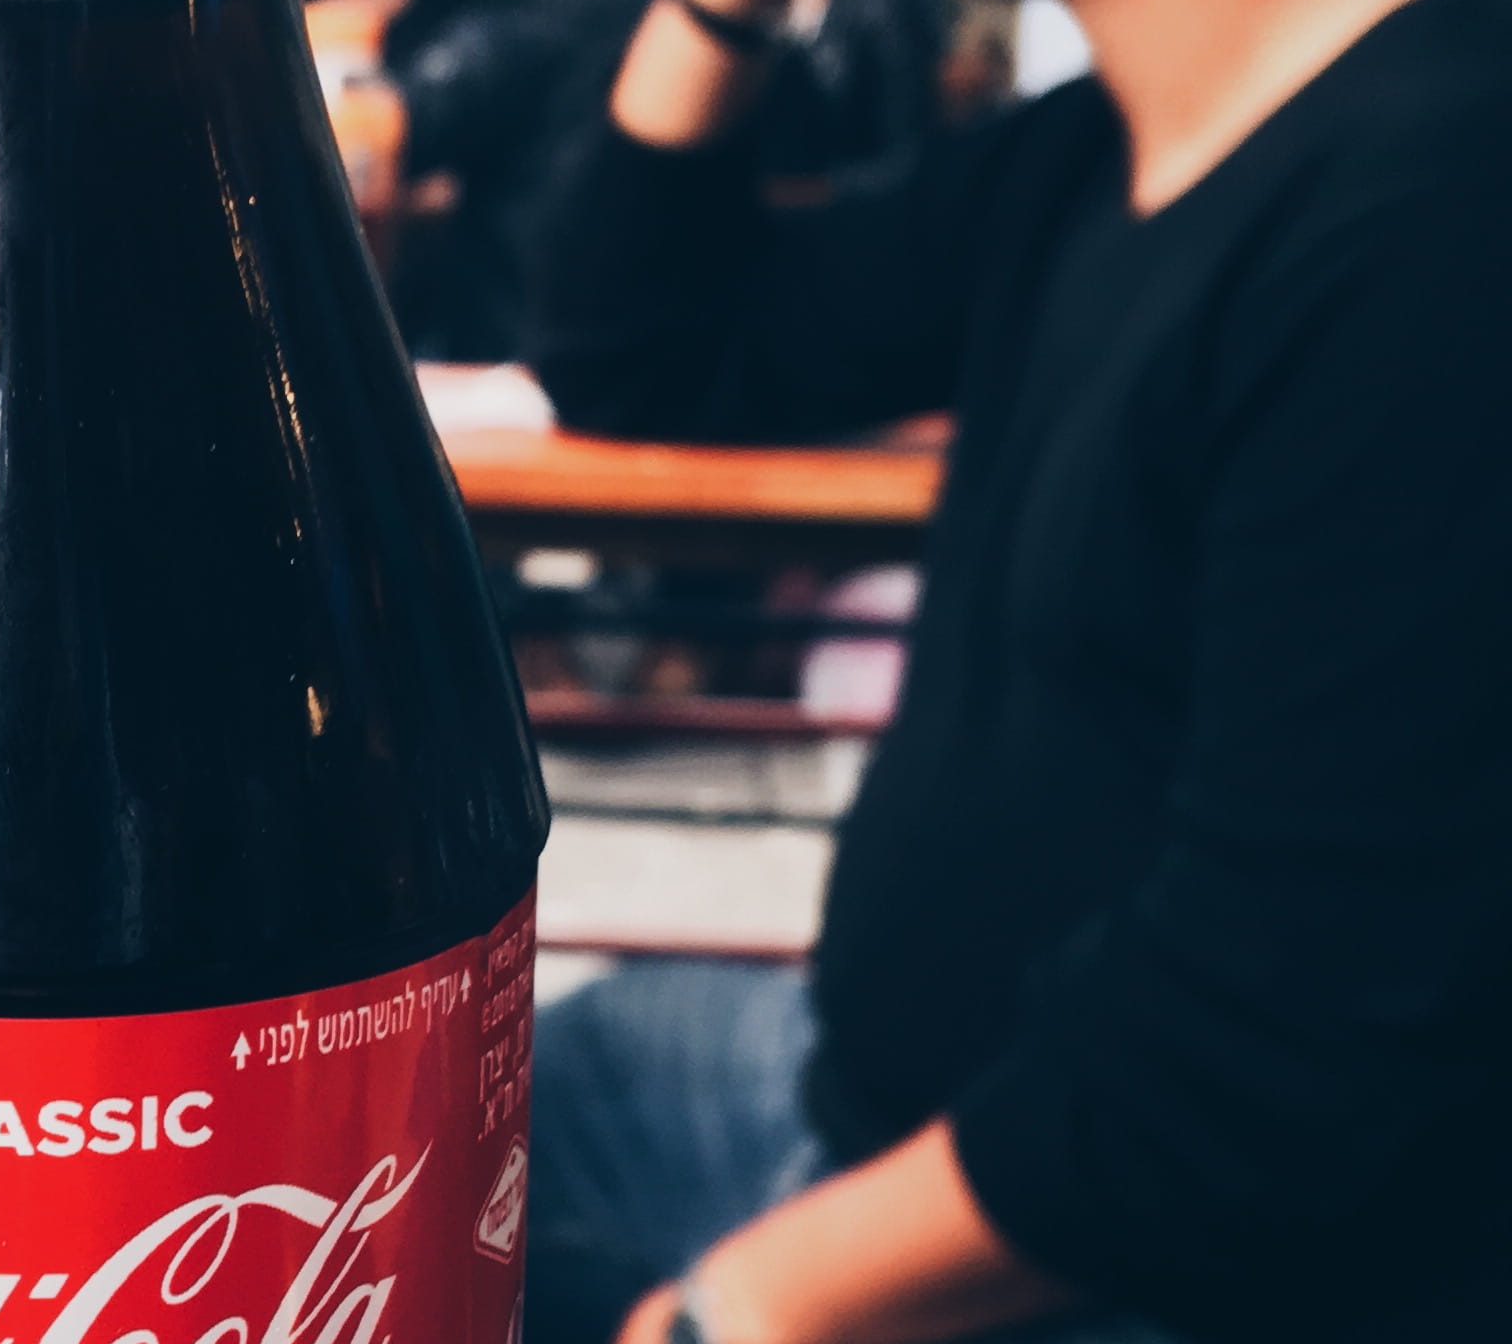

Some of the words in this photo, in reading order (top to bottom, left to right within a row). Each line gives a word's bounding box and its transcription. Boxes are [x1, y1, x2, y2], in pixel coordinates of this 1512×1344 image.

[318, 980, 415, 1054] להשתמש
[421, 972, 459, 1033] עדיף
[259, 1009, 309, 1067] לפני
